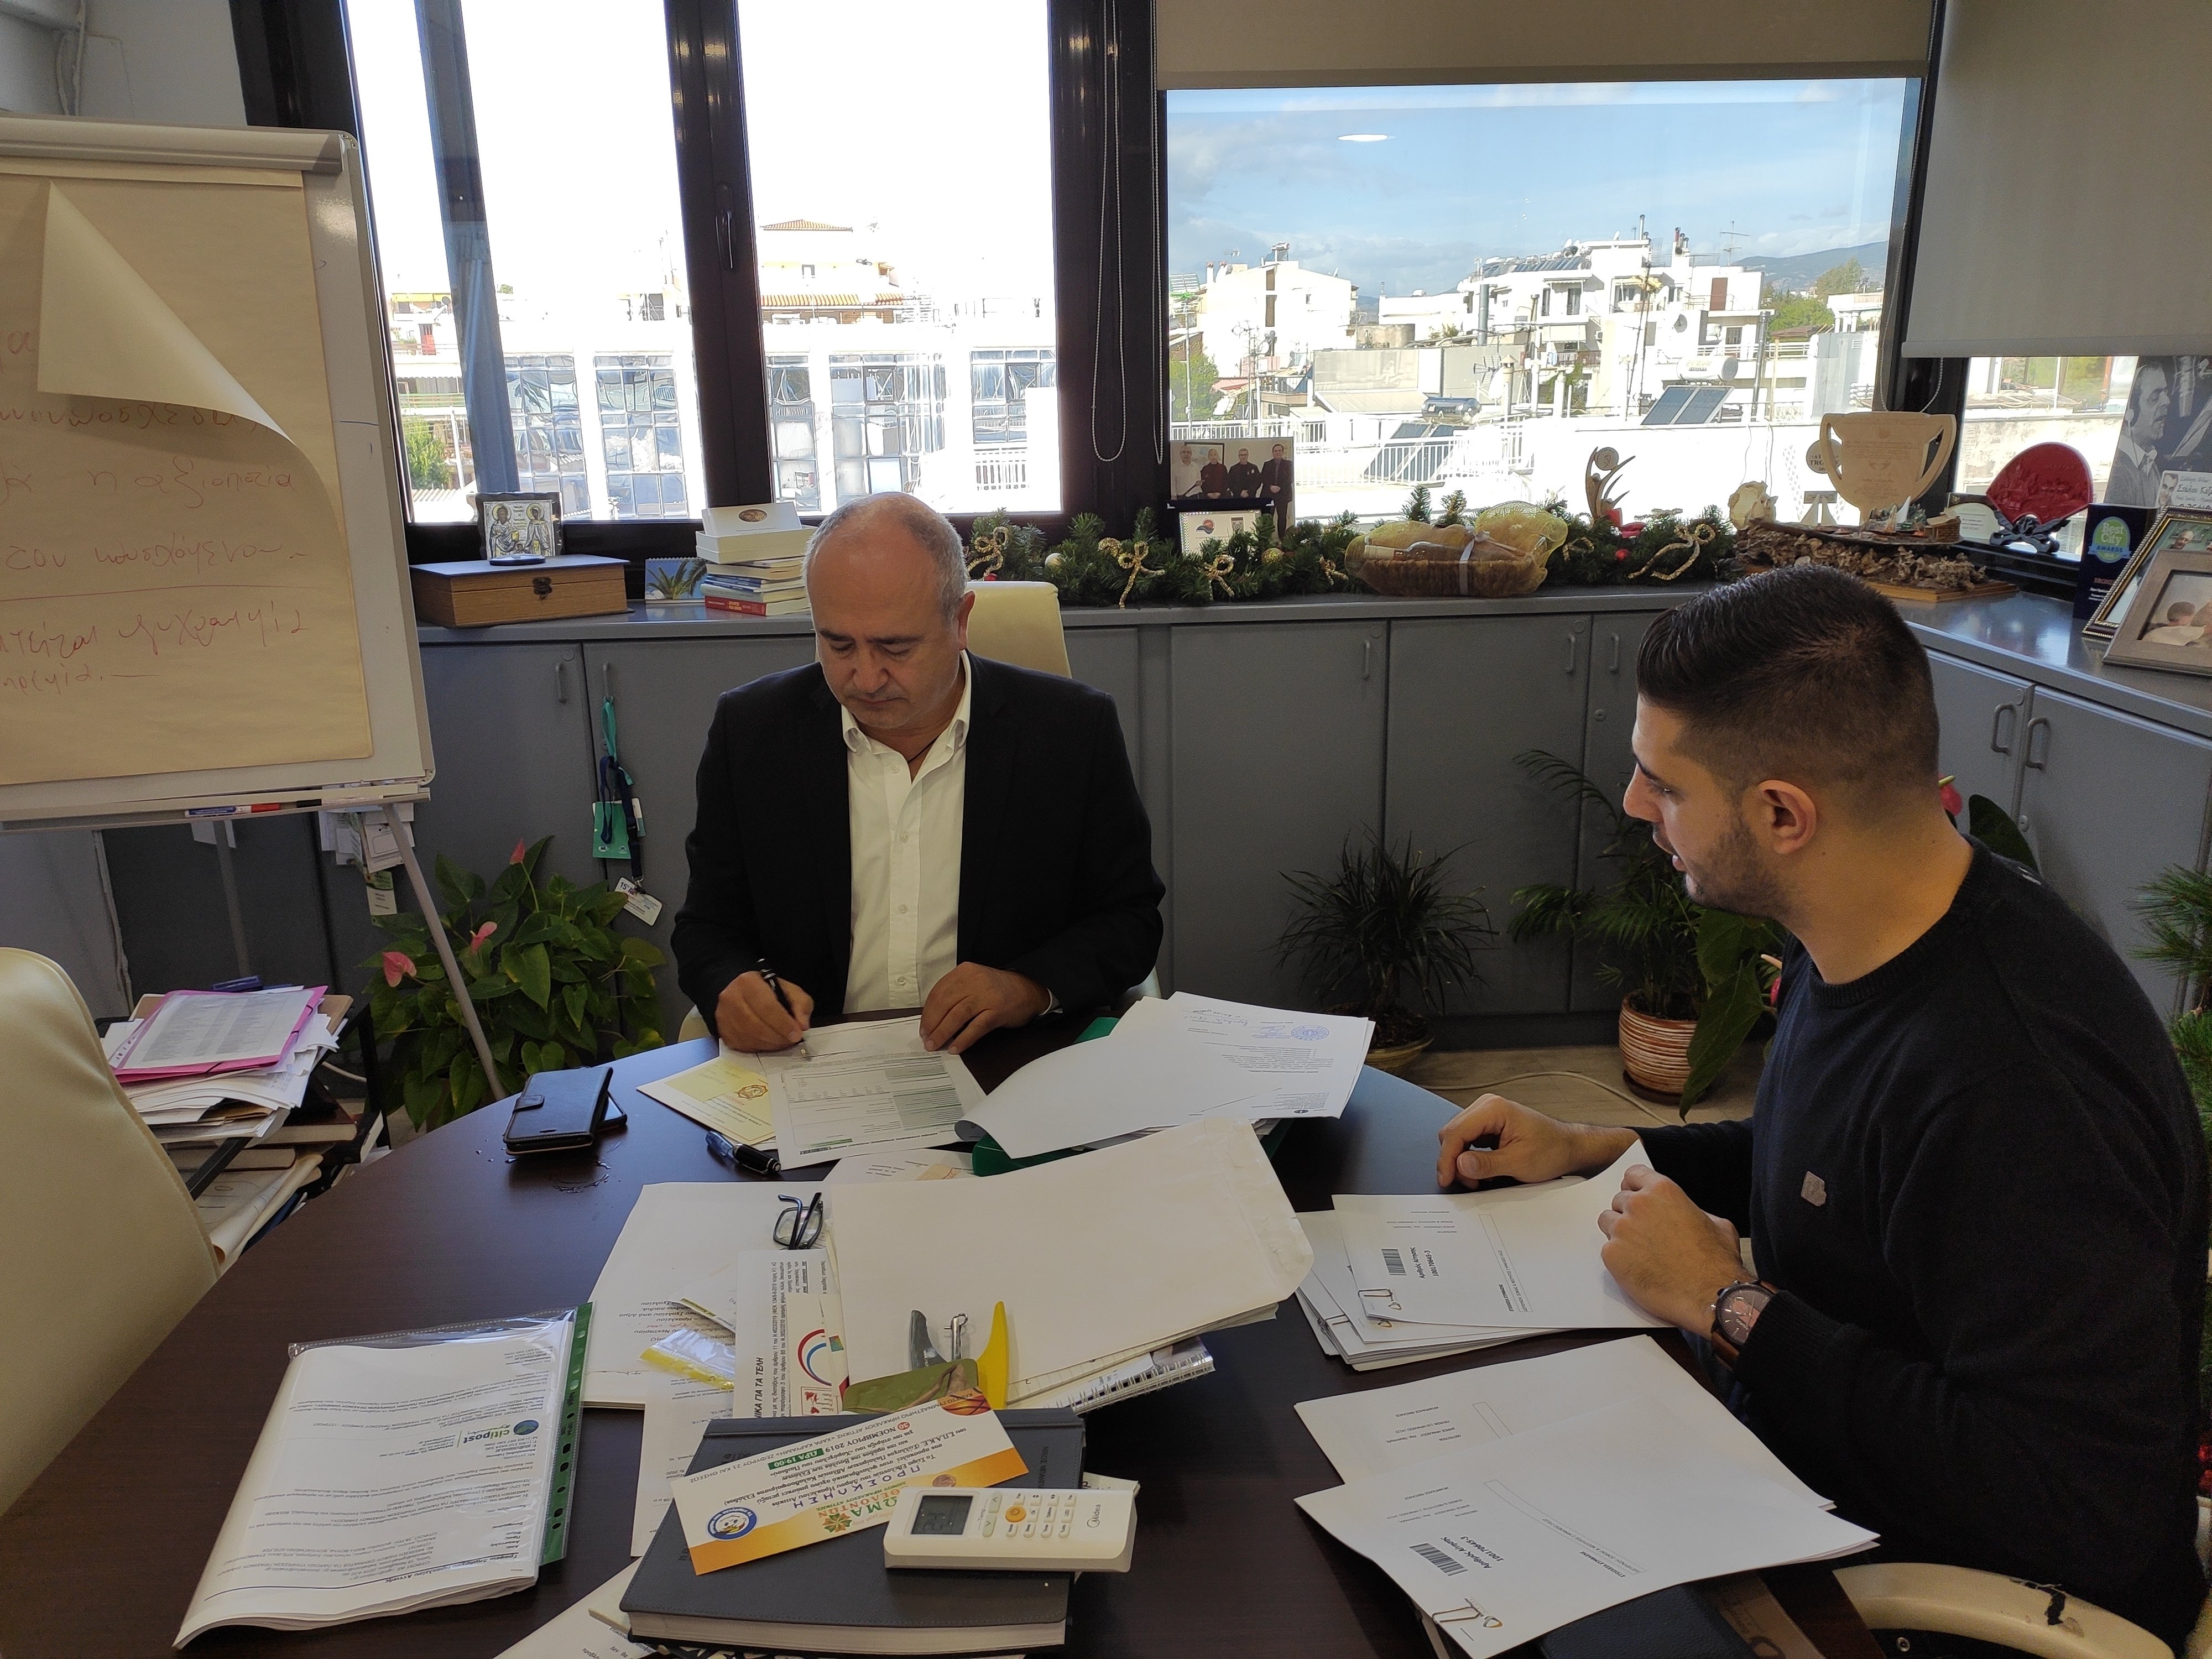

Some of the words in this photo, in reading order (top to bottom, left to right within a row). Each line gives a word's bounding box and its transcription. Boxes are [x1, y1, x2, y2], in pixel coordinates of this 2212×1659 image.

[2102, 523, 2124, 534] Best
[2101, 533, 2122, 545] City
[1410, 1246, 1420, 1262] Αίτησης
[1414, 1263, 1426, 1279] Αριθμός
[755, 1378, 763, 1386] ΤΑ
[900, 1400, 946, 1419] ΓΥΜΝΑΣΤΗΡΙΟ
[863, 1415, 900, 1431] ΗΡΑΚΛΕΙΟΥ
[898, 1421, 909, 1430] 30
[462, 1428, 510, 1445] citipost
[836, 1427, 863, 1439] ΑΤΤΙΚΗΣ
[845, 1425, 896, 1447] ΝΟΕΜΒΡΙΟΥ
[891, 1432, 904, 1441] την
[902, 1428, 914, 1437] για
[813, 1435, 835, 1446] «ΧΑΡΑ
[866, 1436, 892, 1449] στήριξη
[885, 1442, 897, 1451] της
[896, 1438, 909, 1447] και
[930, 1442, 943, 1451] σας
[824, 1442, 845, 1453] 2019
[853, 1444, 866, 1453] του
[885, 1442, 920, 1458] (Σύλλογος
[742, 1453, 774, 1467] ΖΕΦΥΡΟΥ
[797, 1449, 818, 1461] ΩΡΑ
[849, 1453, 861, 1462] της
[895, 1446, 930, 1463] προσκαλεί
[906, 1455, 926, 1467] Σώμα
[925, 1453, 935, 1461] Το
[773, 1455, 797, 1468] 19:00
[800, 1460, 813, 1469] του
[823, 1457, 849, 1470] Βουλής
[846, 1453, 886, 1472] Παλαίμαχων
[878, 1458, 894, 1468] στον
[769, 1463, 801, 1479] Παιδιού»
[781, 1468, 811, 1483] Ελλήνων
[810, 1464, 823, 1474] των
[817, 1465, 846, 1480] Αθλητών
[831, 1463, 878, 1484] φιλανθρωπικό
[872, 1462, 907, 1479] Εθελοντών
[689, 1470, 718, 1483] ΘΗΣΕΩΣ
[809, 1477, 831, 1489] αγώνα
[858, 1473, 872, 1483] του
[1038, 1465, 1046, 1489] ΜΠΑΜΠ
[755, 1474, 817, 1496] Καλαθοσφαίρισης
[792, 1464, 921, 1509] ΠΡΟΣΚΛΗΣΗ
[835, 1477, 859, 1490] Δήμου
[780, 1483, 808, 1498] μπάσκετ
[797, 1484, 836, 1501] Ηρακλείου
[723, 1492, 755, 1506] Ελλάδας)
[755, 1493, 780, 1505] μεταξύ
[771, 1495, 797, 1509] Αττικής
[816, 1499, 844, 1512] ΑΤΤΙΚΗΣ
[817, 1487, 900, 1519] ΘΕΛΟΝΤΩΝ
[849, 1496, 898, 1518] ΩΜΑ
[1086, 1504, 1102, 1528] Midea
[1441, 1536, 1467, 1553] Αίτησης
[488, 1553, 517, 1562] Γραφείο
[1467, 1551, 1492, 1569] Αριθμός
[384, 1573, 412, 1584] Αττικής
